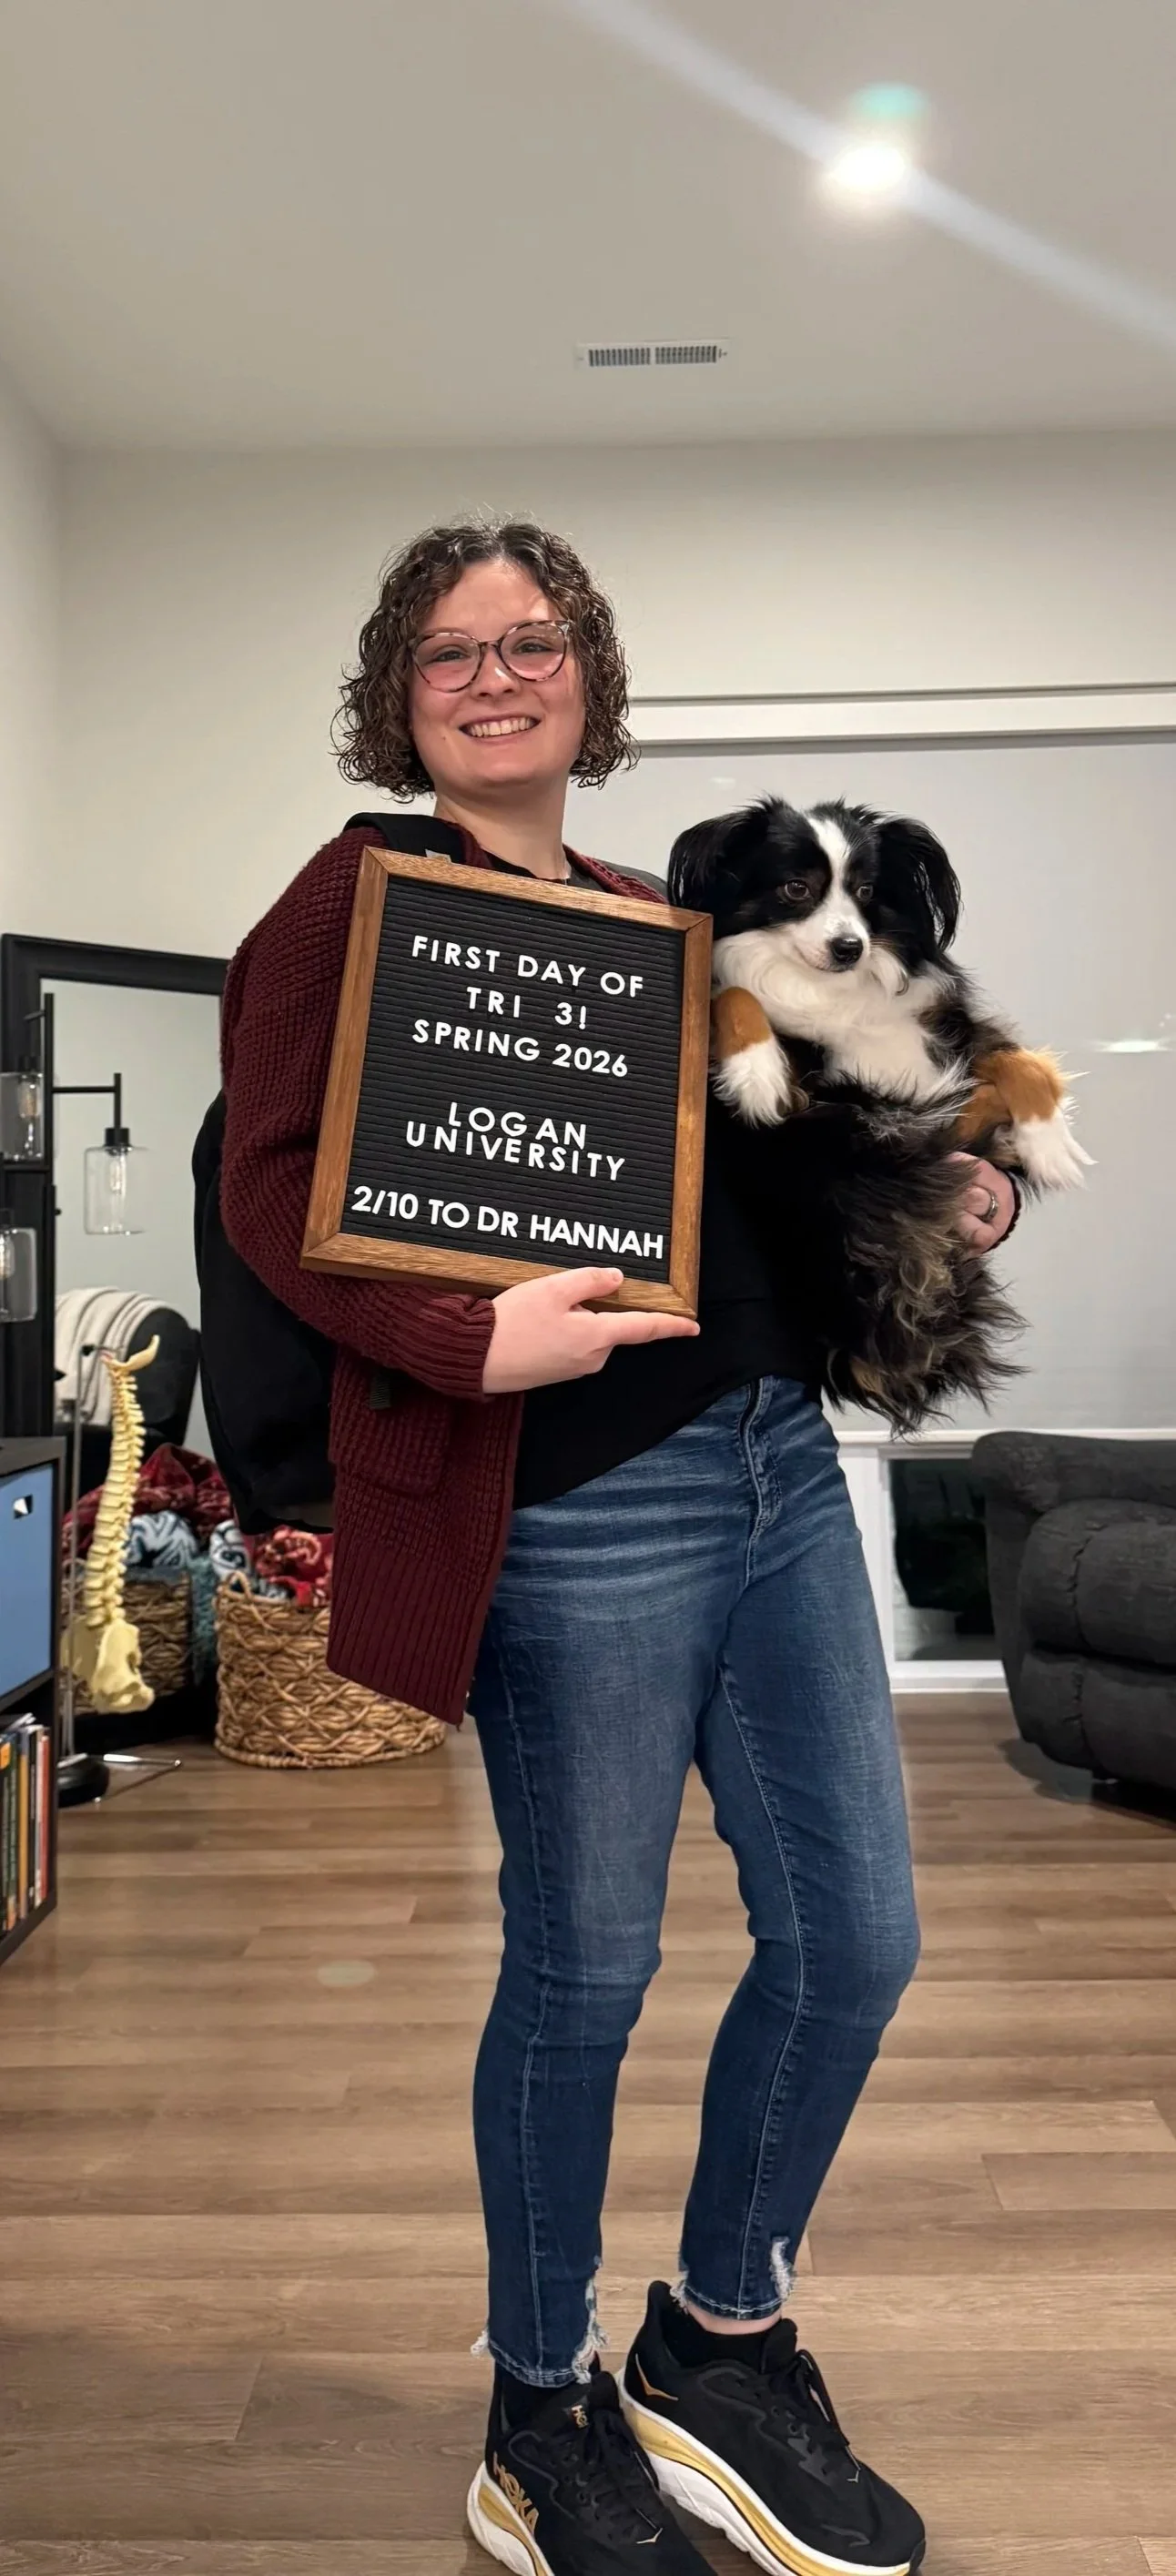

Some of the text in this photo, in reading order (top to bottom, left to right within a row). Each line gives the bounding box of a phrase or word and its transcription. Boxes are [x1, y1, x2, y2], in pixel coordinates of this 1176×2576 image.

[411, 935, 644, 998] FIRST DAY OF
[466, 986, 587, 1030] TRI 3!
[411, 1019, 628, 1078] SPRING 2026
[406, 1121, 625, 1182] UNIVERSITY
[448, 1101, 587, 1151] LOGAN
[350, 1185, 664, 1260] 2/10 TO DR HANNAH
